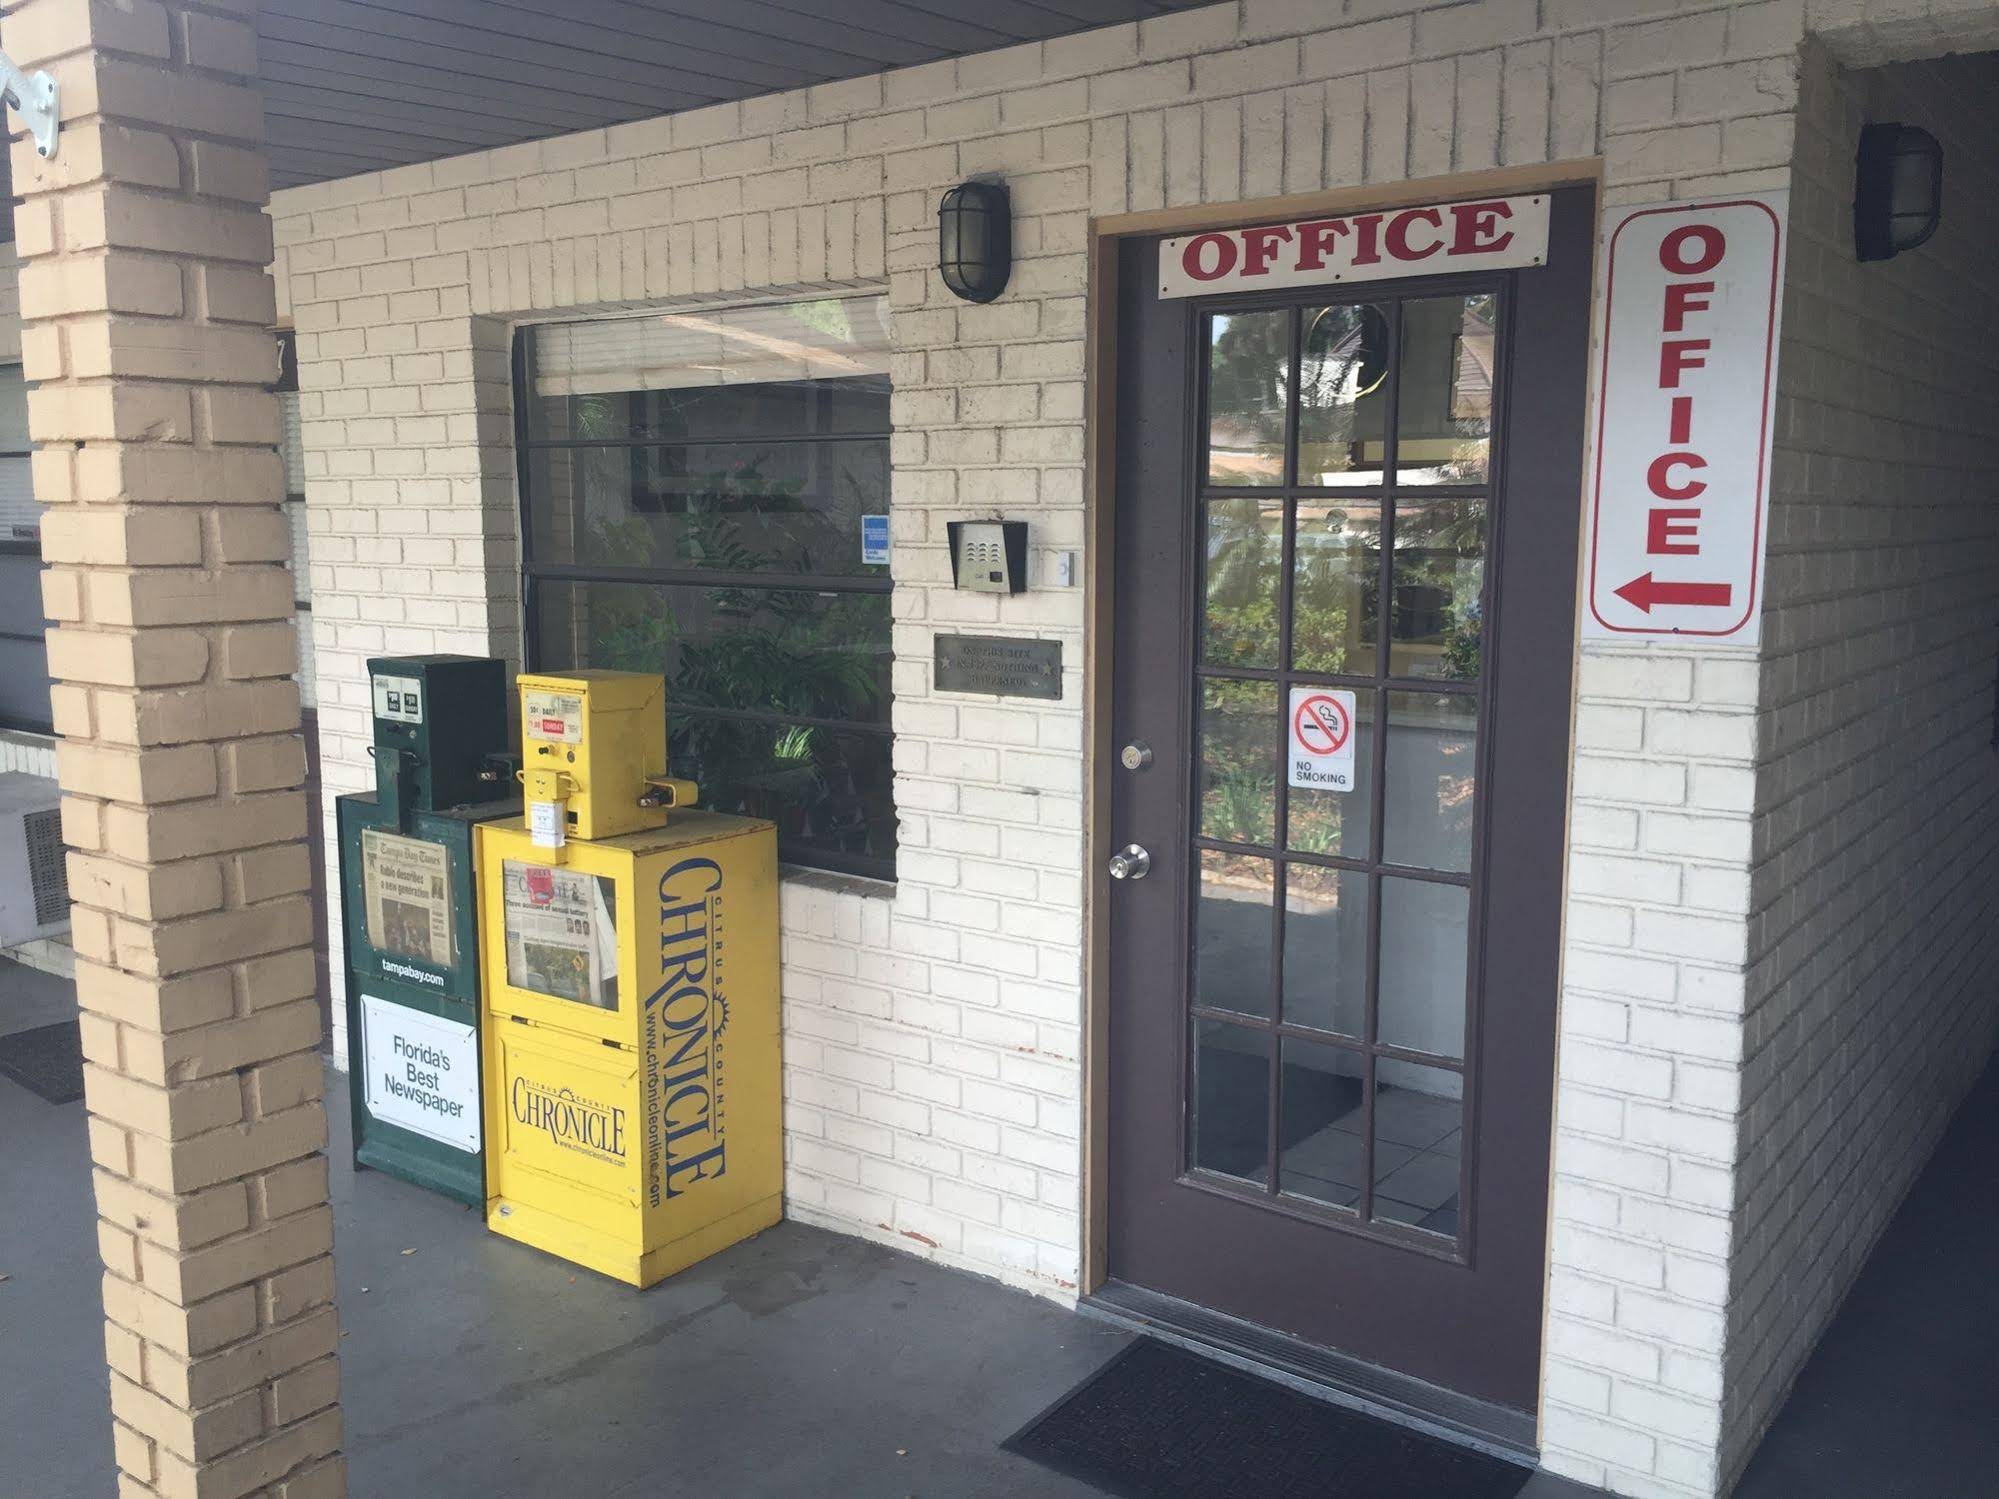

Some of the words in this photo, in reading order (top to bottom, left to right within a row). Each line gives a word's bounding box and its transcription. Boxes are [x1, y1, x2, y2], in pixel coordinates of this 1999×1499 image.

[1182, 201, 1515, 282] OFFICE
[1646, 224, 1726, 555] OFFICE
[1296, 761, 1312, 771] NO
[1296, 771, 1346, 785] SMOKING
[382, 958, 445, 987] tampabay.com
[714, 896, 724, 986] CITRUS
[393, 1034, 451, 1071] Florida's
[645, 857, 726, 1200] CHRONICLE
[384, 1073, 464, 1118] Newspaper
[406, 1062, 440, 1091] Best
[513, 1076, 626, 1157] CHRONICLE
[645, 1011, 662, 1209] www.chronicleonline.com
[716, 1043, 726, 1135] COUNTY
